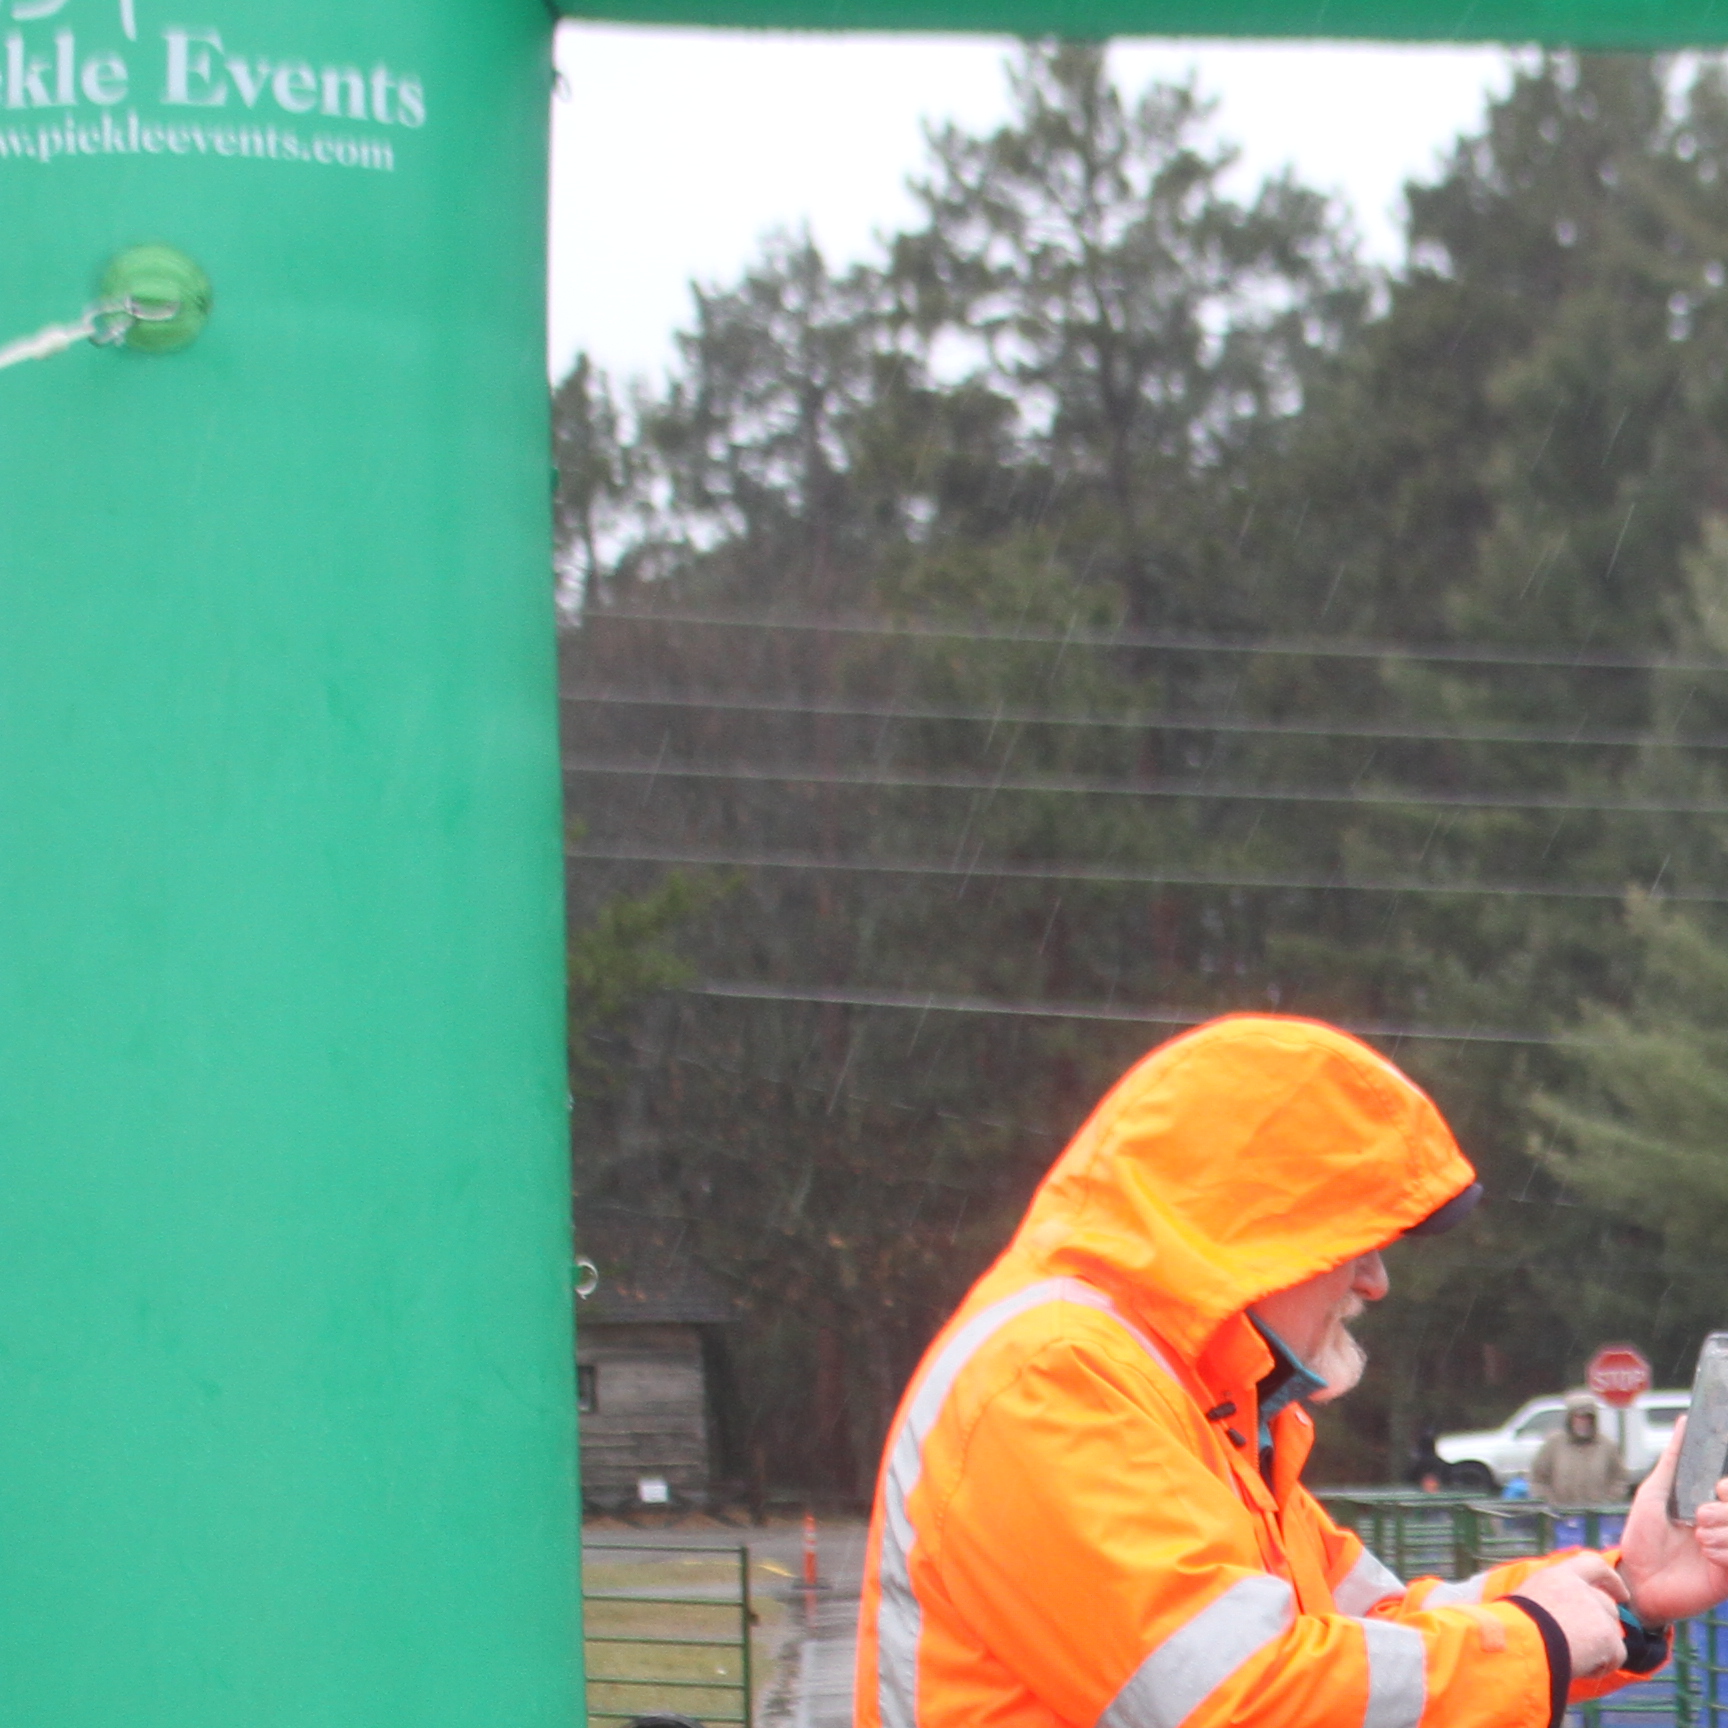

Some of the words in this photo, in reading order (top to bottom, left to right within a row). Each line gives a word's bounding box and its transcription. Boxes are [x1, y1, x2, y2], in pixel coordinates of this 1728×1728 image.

[0, 29, 129, 109] kle
[161, 29, 427, 128] Events
[1594, 1369, 1647, 1393] STOP
